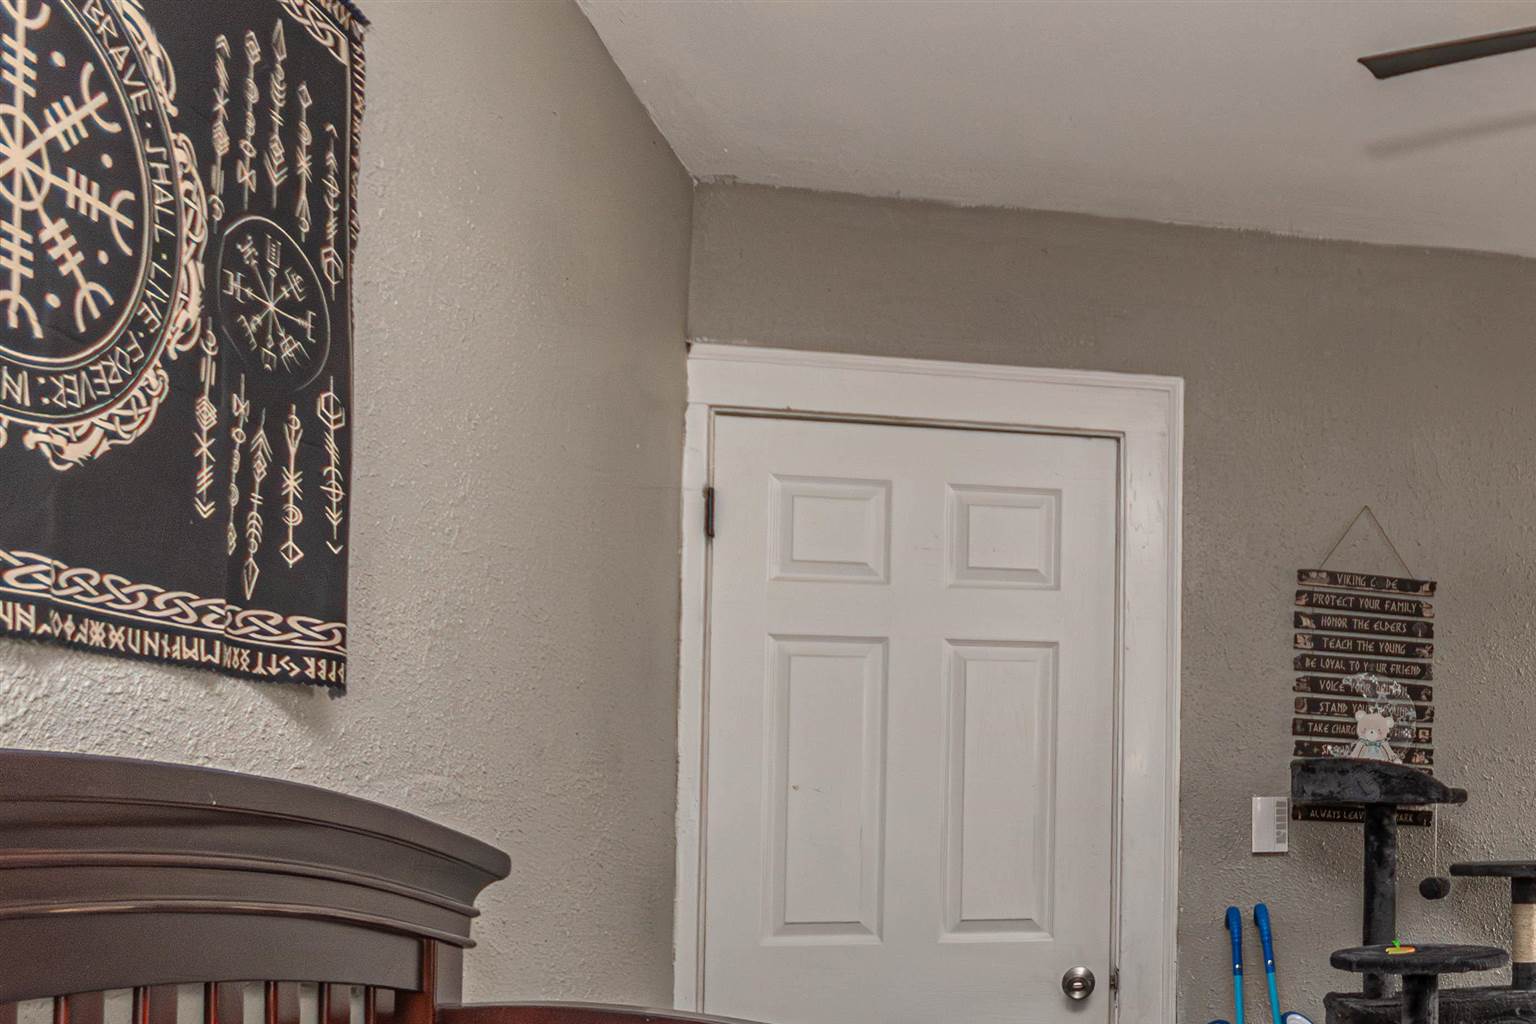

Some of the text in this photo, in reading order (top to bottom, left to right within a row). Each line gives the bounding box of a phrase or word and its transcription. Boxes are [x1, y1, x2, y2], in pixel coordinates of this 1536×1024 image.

[137, 261, 172, 333] LIVE
[1337, 574, 1366, 587] VIKING
[1312, 593, 1418, 614] PROTECT YOUR FAMILY
[1320, 616, 1407, 633] HONOR THE ELDERS
[1323, 637, 1407, 655] TEACH THE YOUNG
[1305, 657, 1317, 668] BE
[1320, 658, 1346, 670] LOYAL
[1350, 660, 1360, 670] TO
[1319, 679, 1345, 692] VOICE
[1319, 702, 1348, 714] STAND
[1353, 703, 1374, 714] YOU
[1308, 722, 1358, 736] TAKE CHARG
[1310, 808, 1341, 820] ALWAYS
[1343, 809, 1365, 820] LEAV
